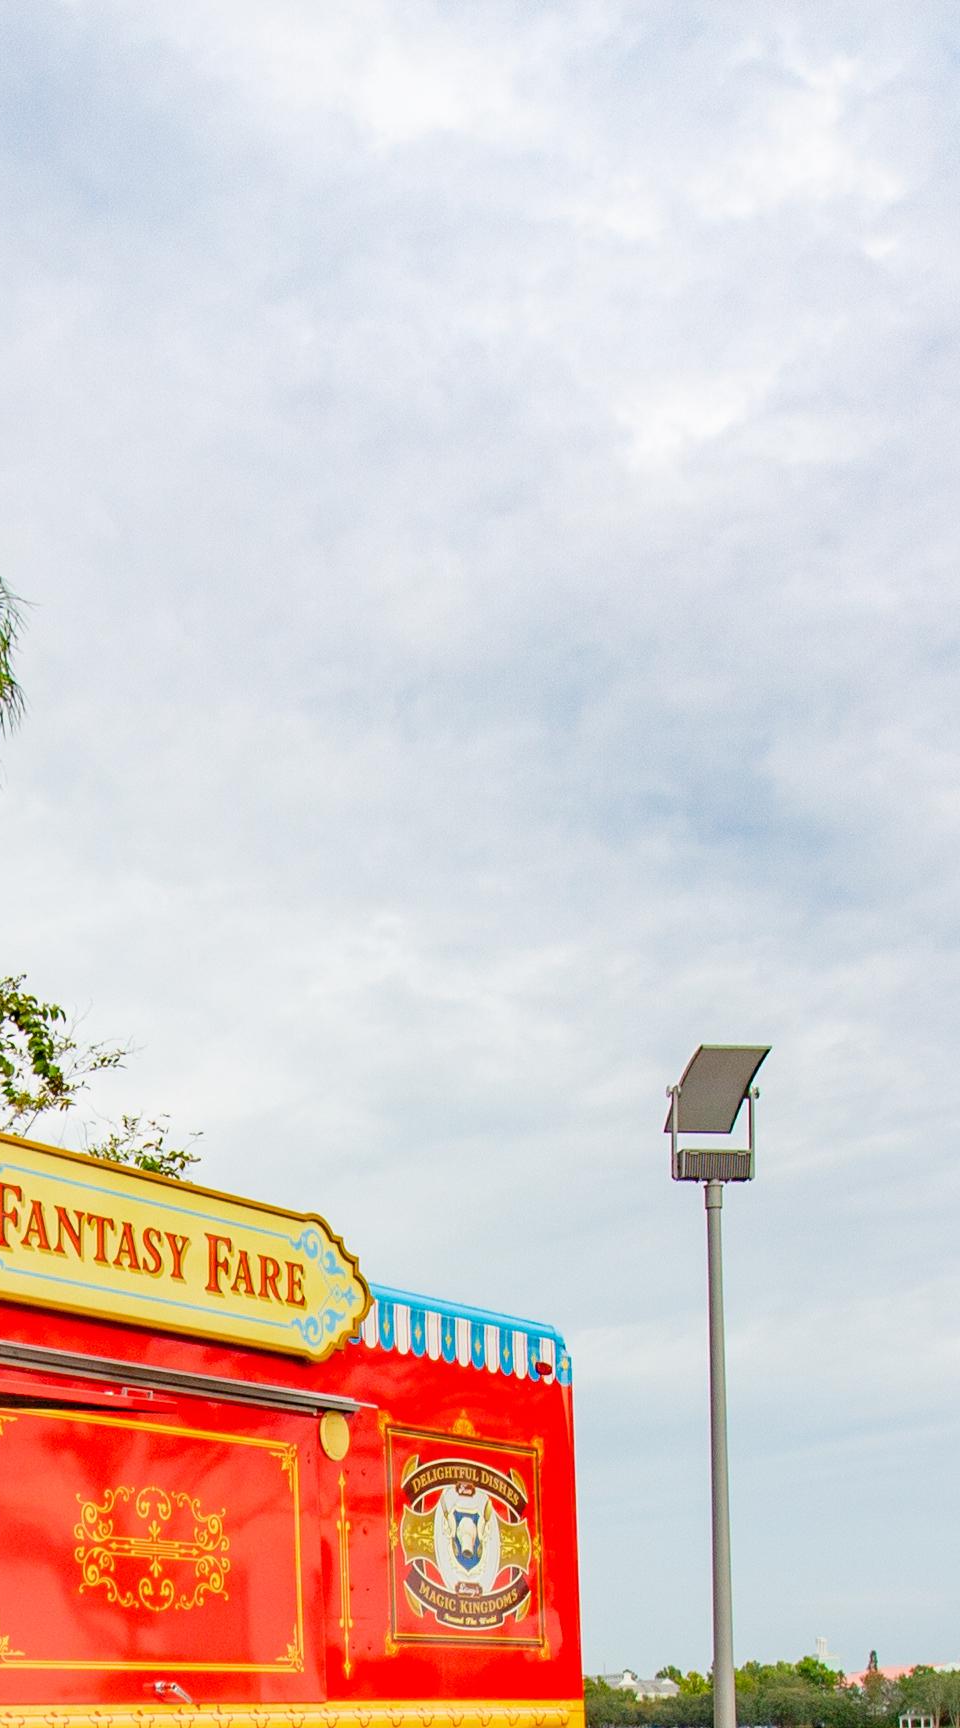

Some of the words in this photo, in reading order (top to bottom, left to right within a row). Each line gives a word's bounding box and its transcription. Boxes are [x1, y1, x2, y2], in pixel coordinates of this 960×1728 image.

[411, 1466, 480, 1494] DELIGHTFUL
[481, 1470, 520, 1506] DISHES
[419, 1581, 456, 1612] MAGIC
[460, 1588, 519, 1615] KINGDOMS
